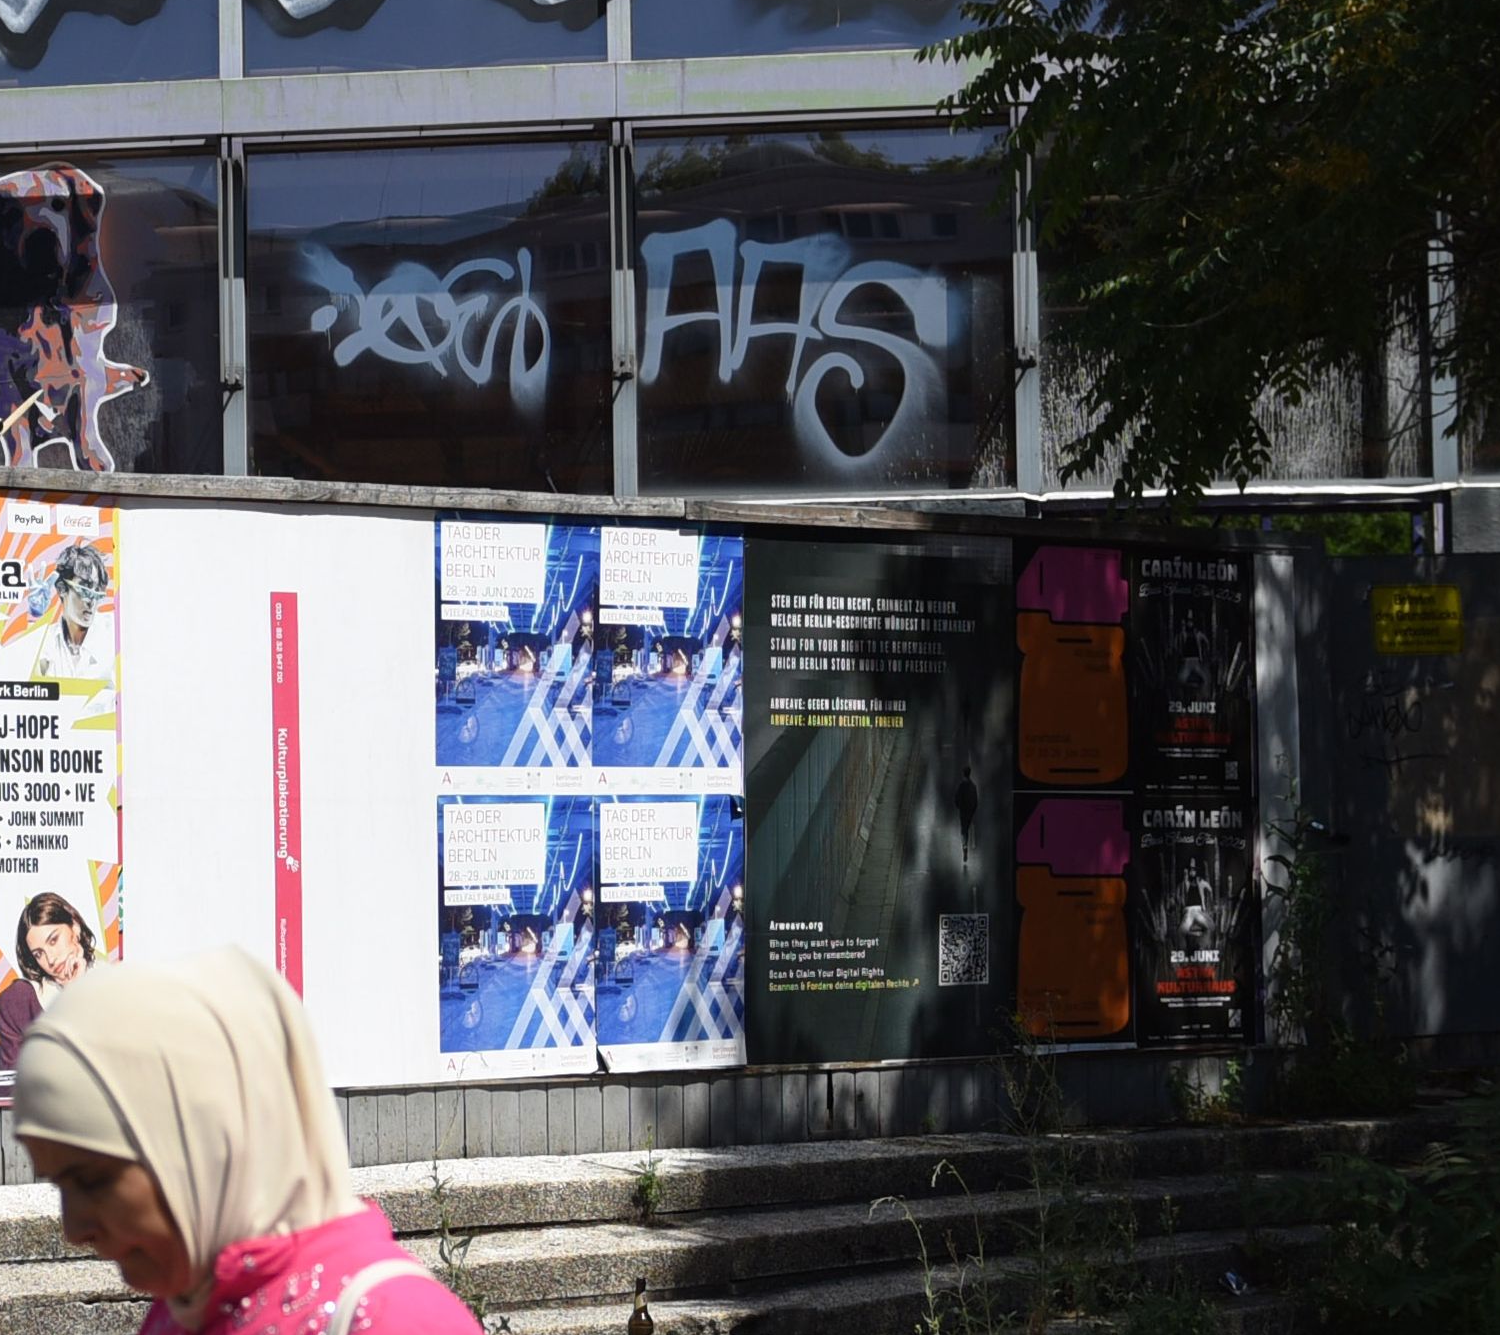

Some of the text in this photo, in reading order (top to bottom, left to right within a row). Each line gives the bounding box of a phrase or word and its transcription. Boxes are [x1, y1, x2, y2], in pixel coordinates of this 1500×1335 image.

[446, 526, 500, 540] TAG DER
[446, 544, 540, 561] ARCHITEKTUR
[446, 563, 496, 578] BERLIN
[771, 594, 807, 609] STEH EIN
[51, 749, 103, 774] BOONE
[24, 781, 61, 802] 3000
[75, 782, 95, 802] IVE
[8, 811, 36, 826] JOHN
[40, 811, 84, 827] SUMMIT
[769, 920, 823, 932] Arweave.org
